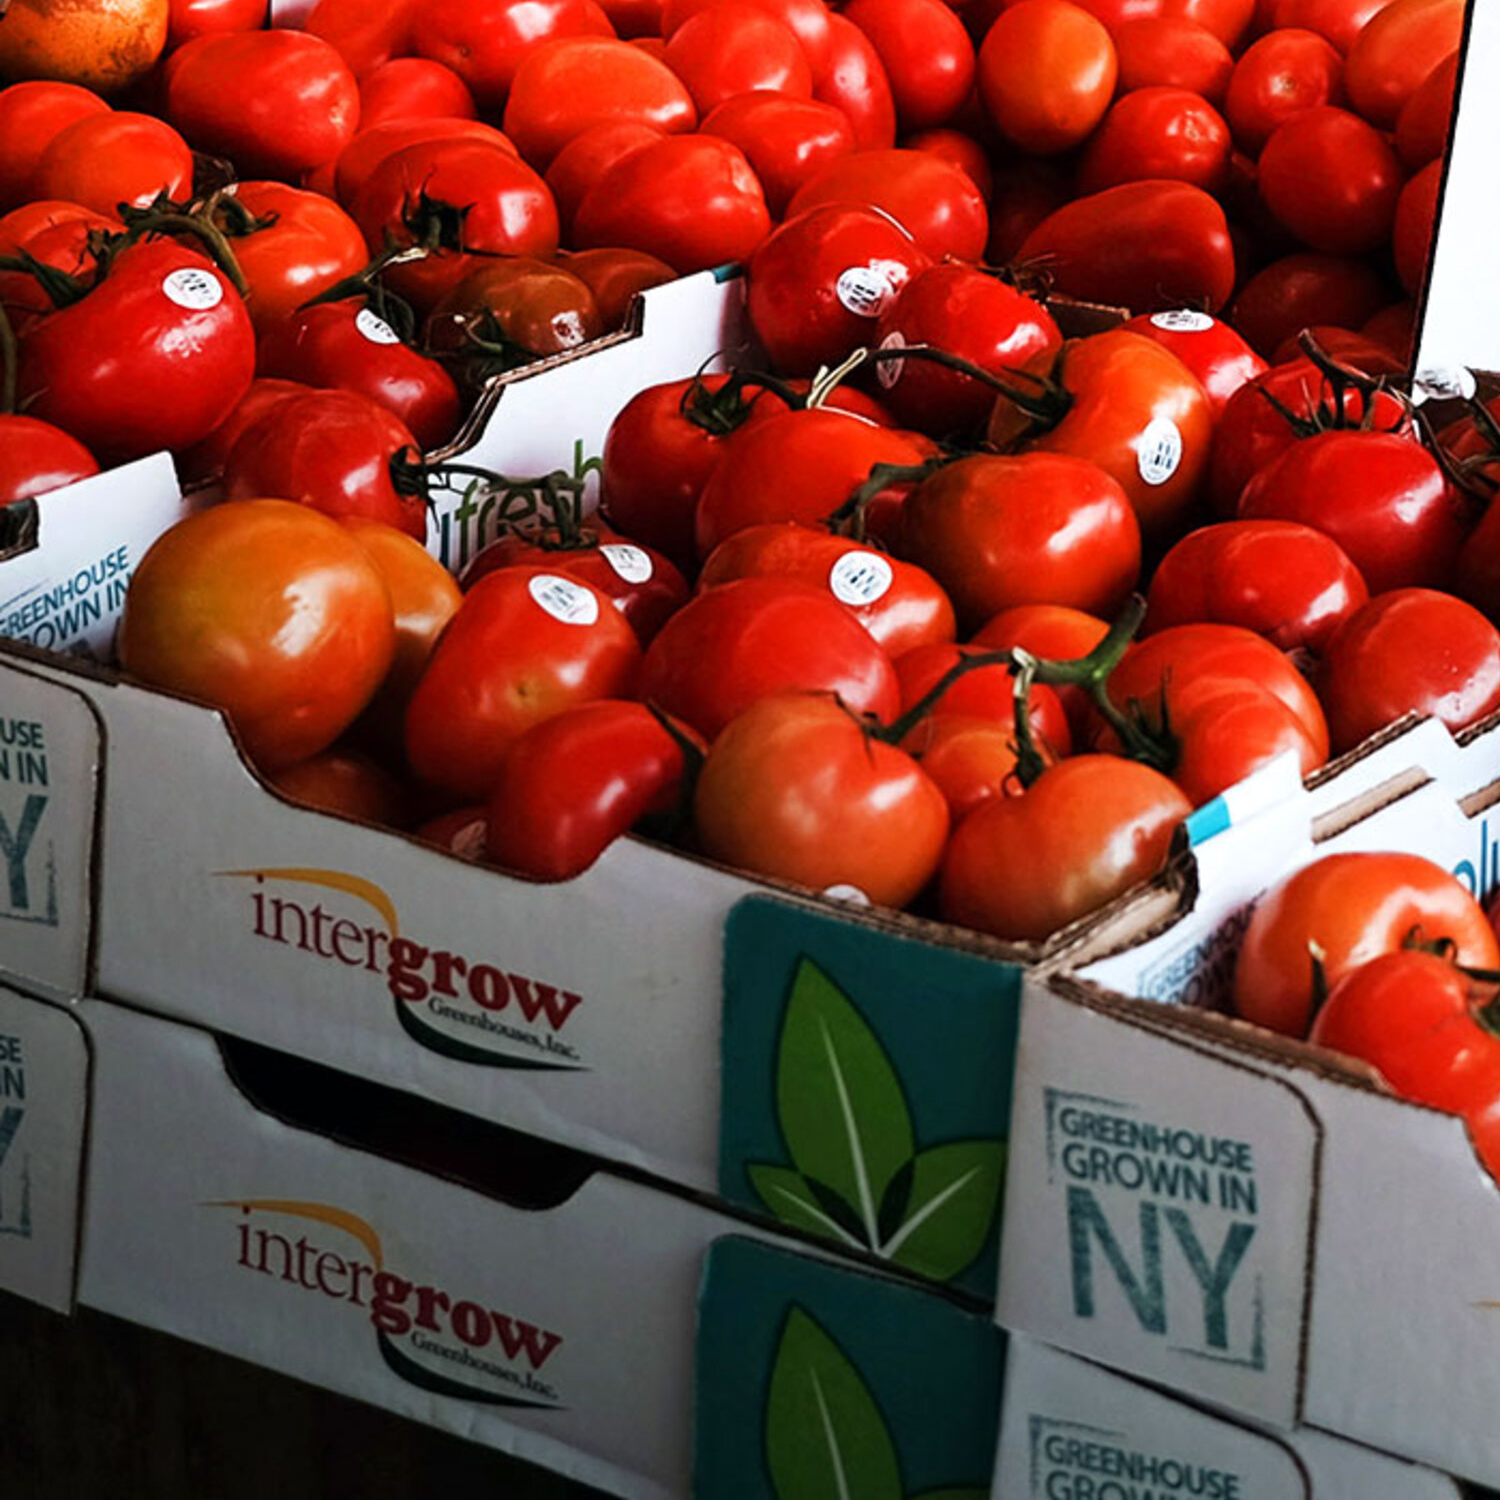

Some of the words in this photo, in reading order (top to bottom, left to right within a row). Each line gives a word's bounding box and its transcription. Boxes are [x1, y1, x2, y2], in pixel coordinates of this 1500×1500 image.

[251, 874, 584, 1032] intergrow
[1058, 1106, 1253, 1173] GREENHOUSE
[1062, 1143, 1204, 1206] GROWN
[1218, 1167, 1259, 1215] IN
[236, 1205, 565, 1370] intergrow
[1065, 1185, 1258, 1352] NY
[1045, 1435, 1240, 1500] GREENHOUSE
